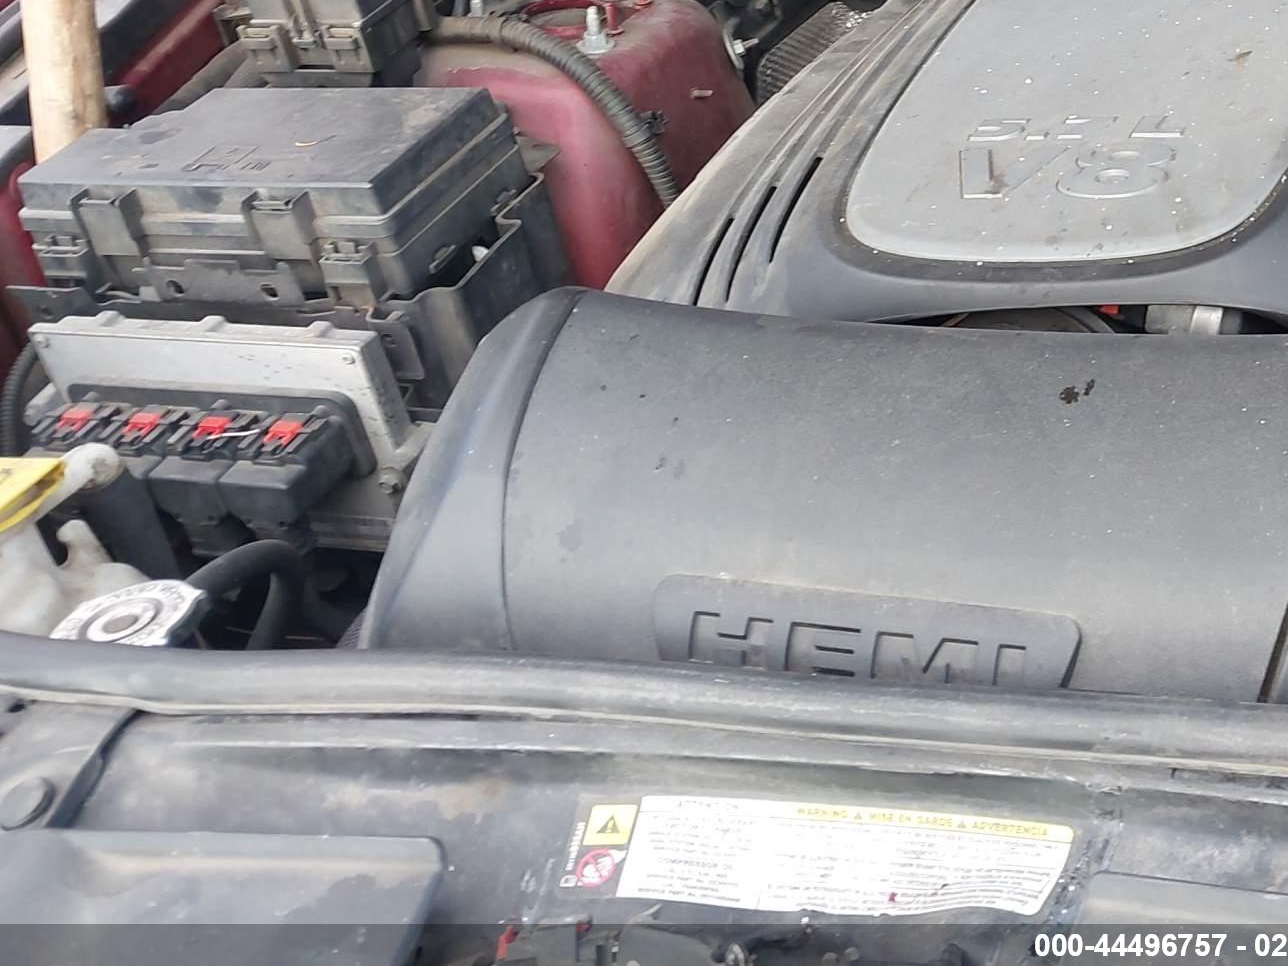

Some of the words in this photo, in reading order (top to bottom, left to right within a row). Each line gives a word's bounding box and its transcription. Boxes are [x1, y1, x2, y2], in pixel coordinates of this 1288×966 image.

[958, 141, 1178, 200] V8
[687, 610, 1029, 688] HEMI
[796, 807, 849, 820] WARNING
[868, 812, 895, 822] MISE
[917, 815, 953, 827] GARDE
[971, 819, 1048, 836] ADVERTENCIA
